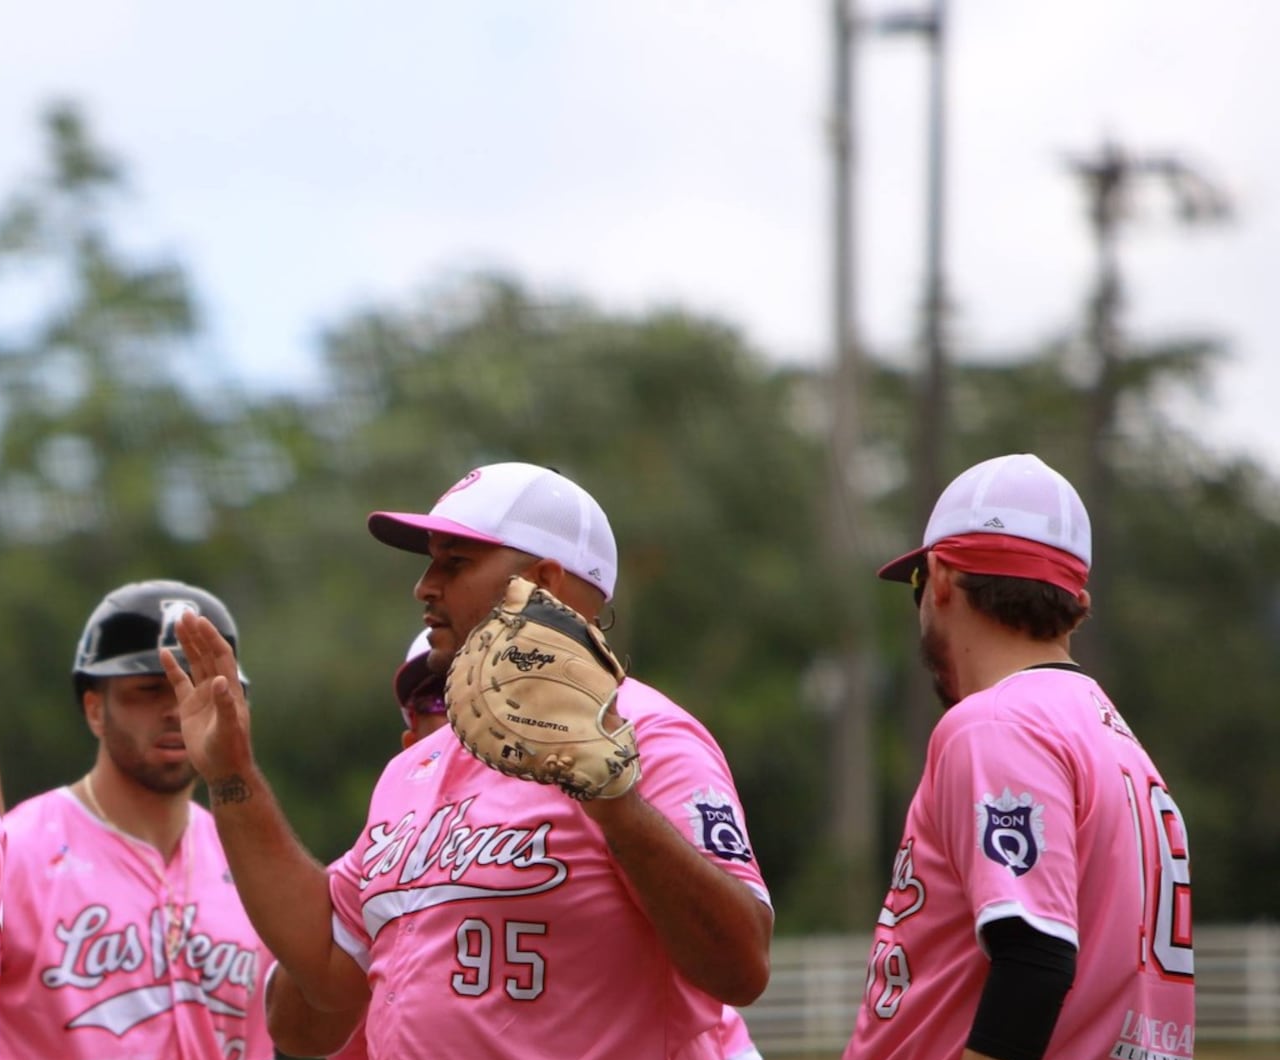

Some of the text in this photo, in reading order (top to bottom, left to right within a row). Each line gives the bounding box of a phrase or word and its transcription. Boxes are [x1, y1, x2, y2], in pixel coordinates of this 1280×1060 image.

[500, 645, 556, 671] Rawlings
[705, 810, 734, 823] DON
[991, 813, 1024, 828] DON
[398, 792, 553, 883] Vegas
[711, 822, 752, 858] Q
[991, 828, 1029, 868] Q
[40, 904, 146, 990] Las
[451, 917, 549, 1001] 95
